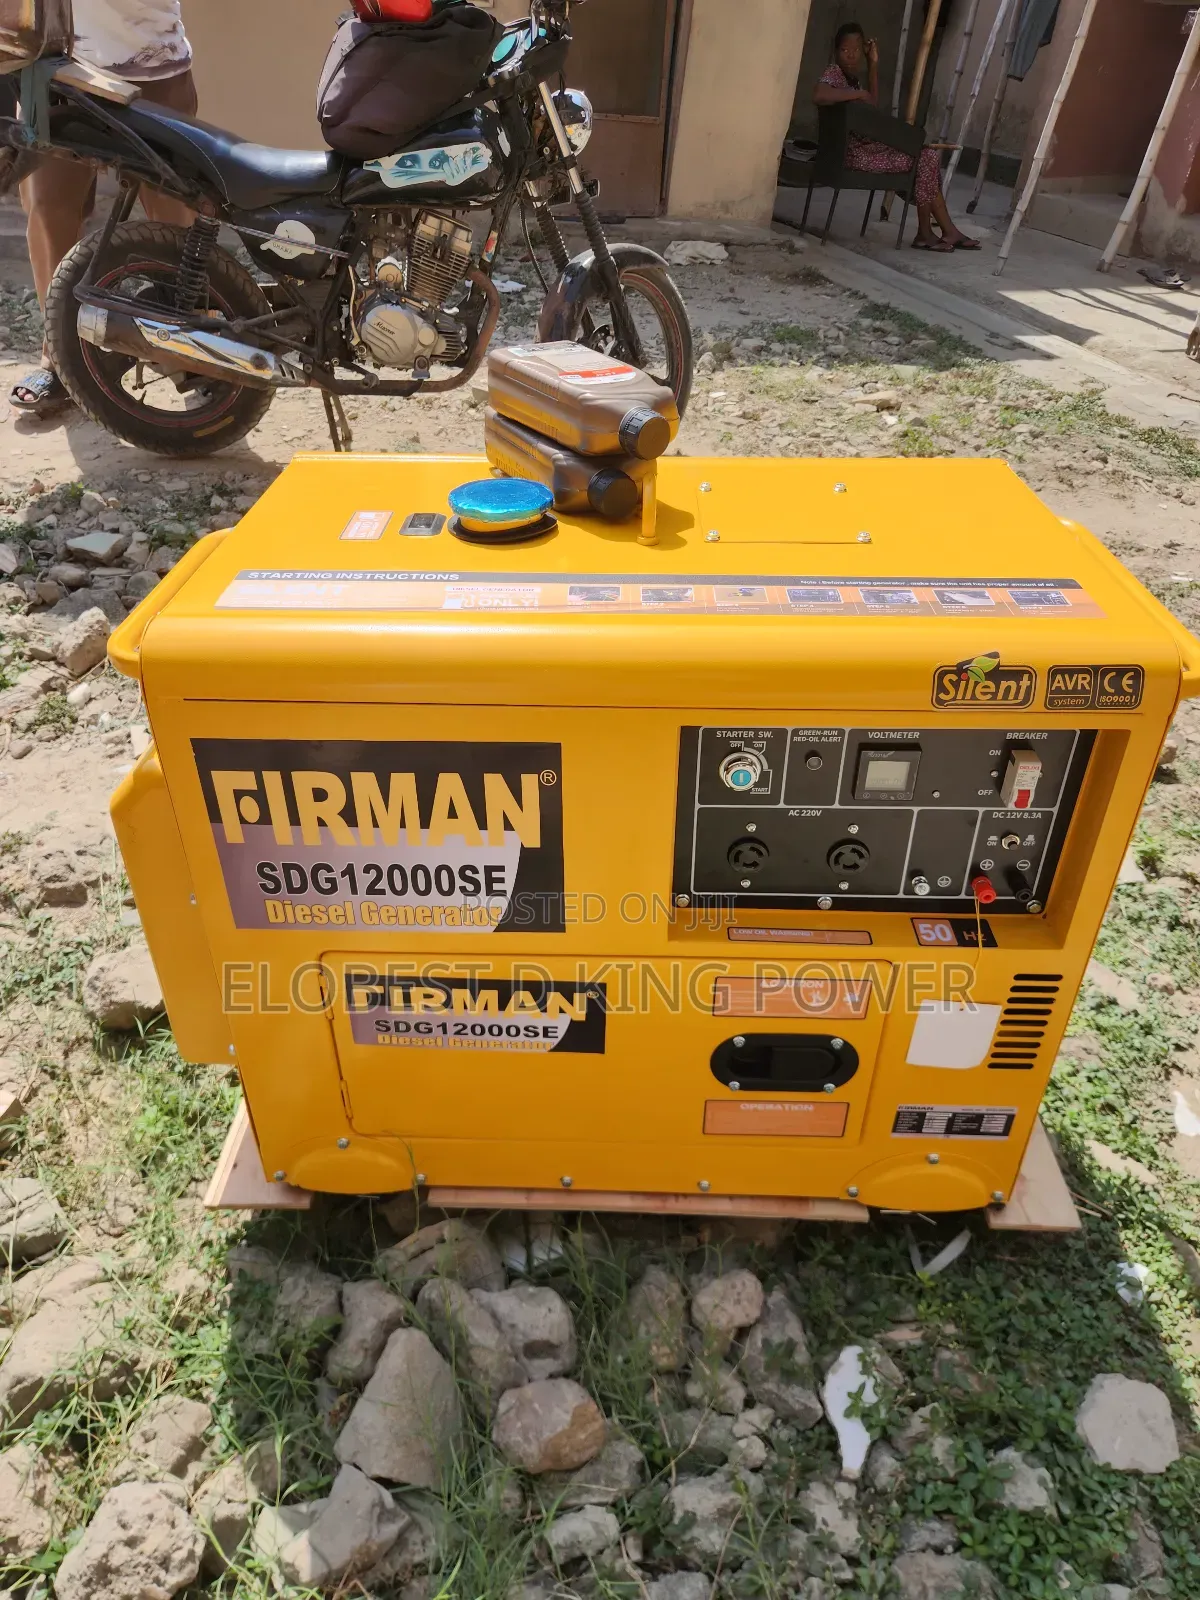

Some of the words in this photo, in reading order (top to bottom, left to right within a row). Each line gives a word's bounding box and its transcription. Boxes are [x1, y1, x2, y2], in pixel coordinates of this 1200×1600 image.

[335, 572, 460, 580] INSTRUCTIONS
[938, 671, 1031, 701] Silent
[1051, 673, 1090, 691] AVR
[1053, 698, 1085, 707] system
[1099, 695, 1136, 703] ISO9001
[716, 730, 755, 738] STARTER
[757, 730, 774, 738] SW.
[867, 731, 920, 739] VOLTMETER
[1005, 732, 1049, 740] BREAKER
[788, 809, 801, 817] AC
[801, 809, 823, 817] 220V
[992, 811, 1005, 819] DC
[1006, 811, 1023, 819] 12V
[1022, 811, 1042, 819] 8.3A
[255, 860, 508, 897] SDG12000SE
[264, 899, 357, 925] Diesel
[360, 902, 503, 927] Generator
[918, 923, 952, 942] 50
[374, 1019, 559, 1039] SDG12000SE
[377, 1034, 443, 1047] Diesel
[447, 1036, 556, 1051] Generator
[739, 1103, 815, 1111] OPERATION
